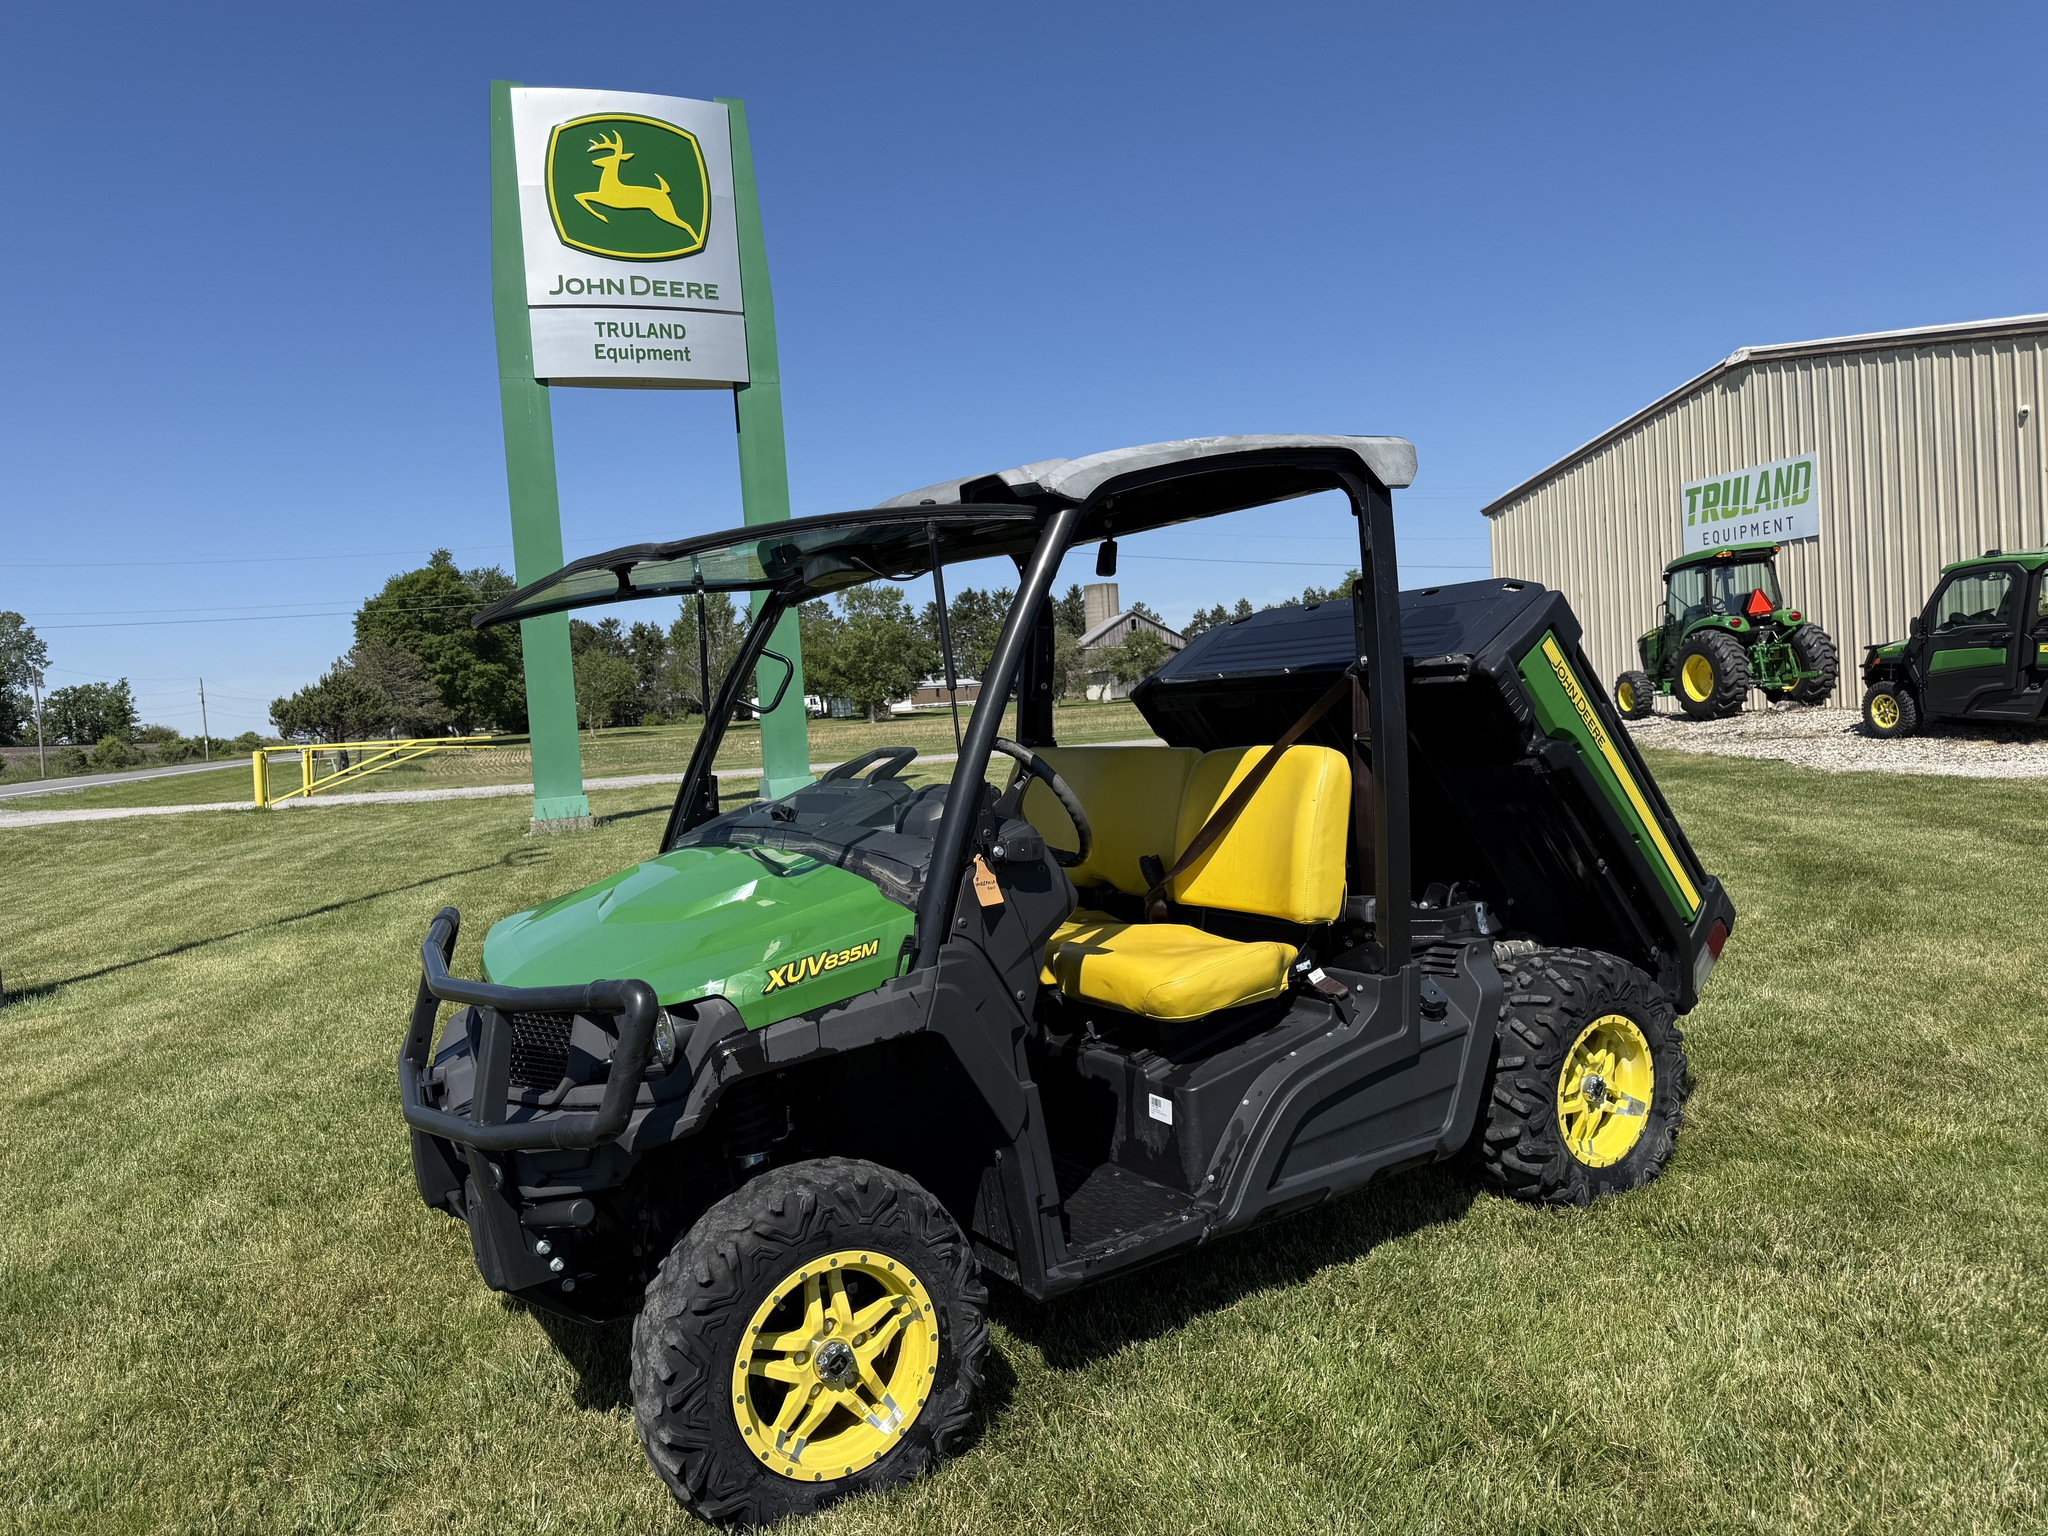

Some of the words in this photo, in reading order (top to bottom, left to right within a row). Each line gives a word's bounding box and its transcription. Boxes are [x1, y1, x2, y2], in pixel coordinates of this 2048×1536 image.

[549, 274, 625, 296] JOHN
[630, 275, 720, 301] DEERE
[594, 321, 687, 340] TRULAND
[593, 343, 692, 363] Equipment
[1685, 460, 1812, 527] TRULAND
[1702, 516, 1794, 546] EQUIPMENT
[1551, 660, 1578, 700] JOHN
[1575, 698, 1606, 749] DEERE
[763, 938, 880, 995] XUV835M
